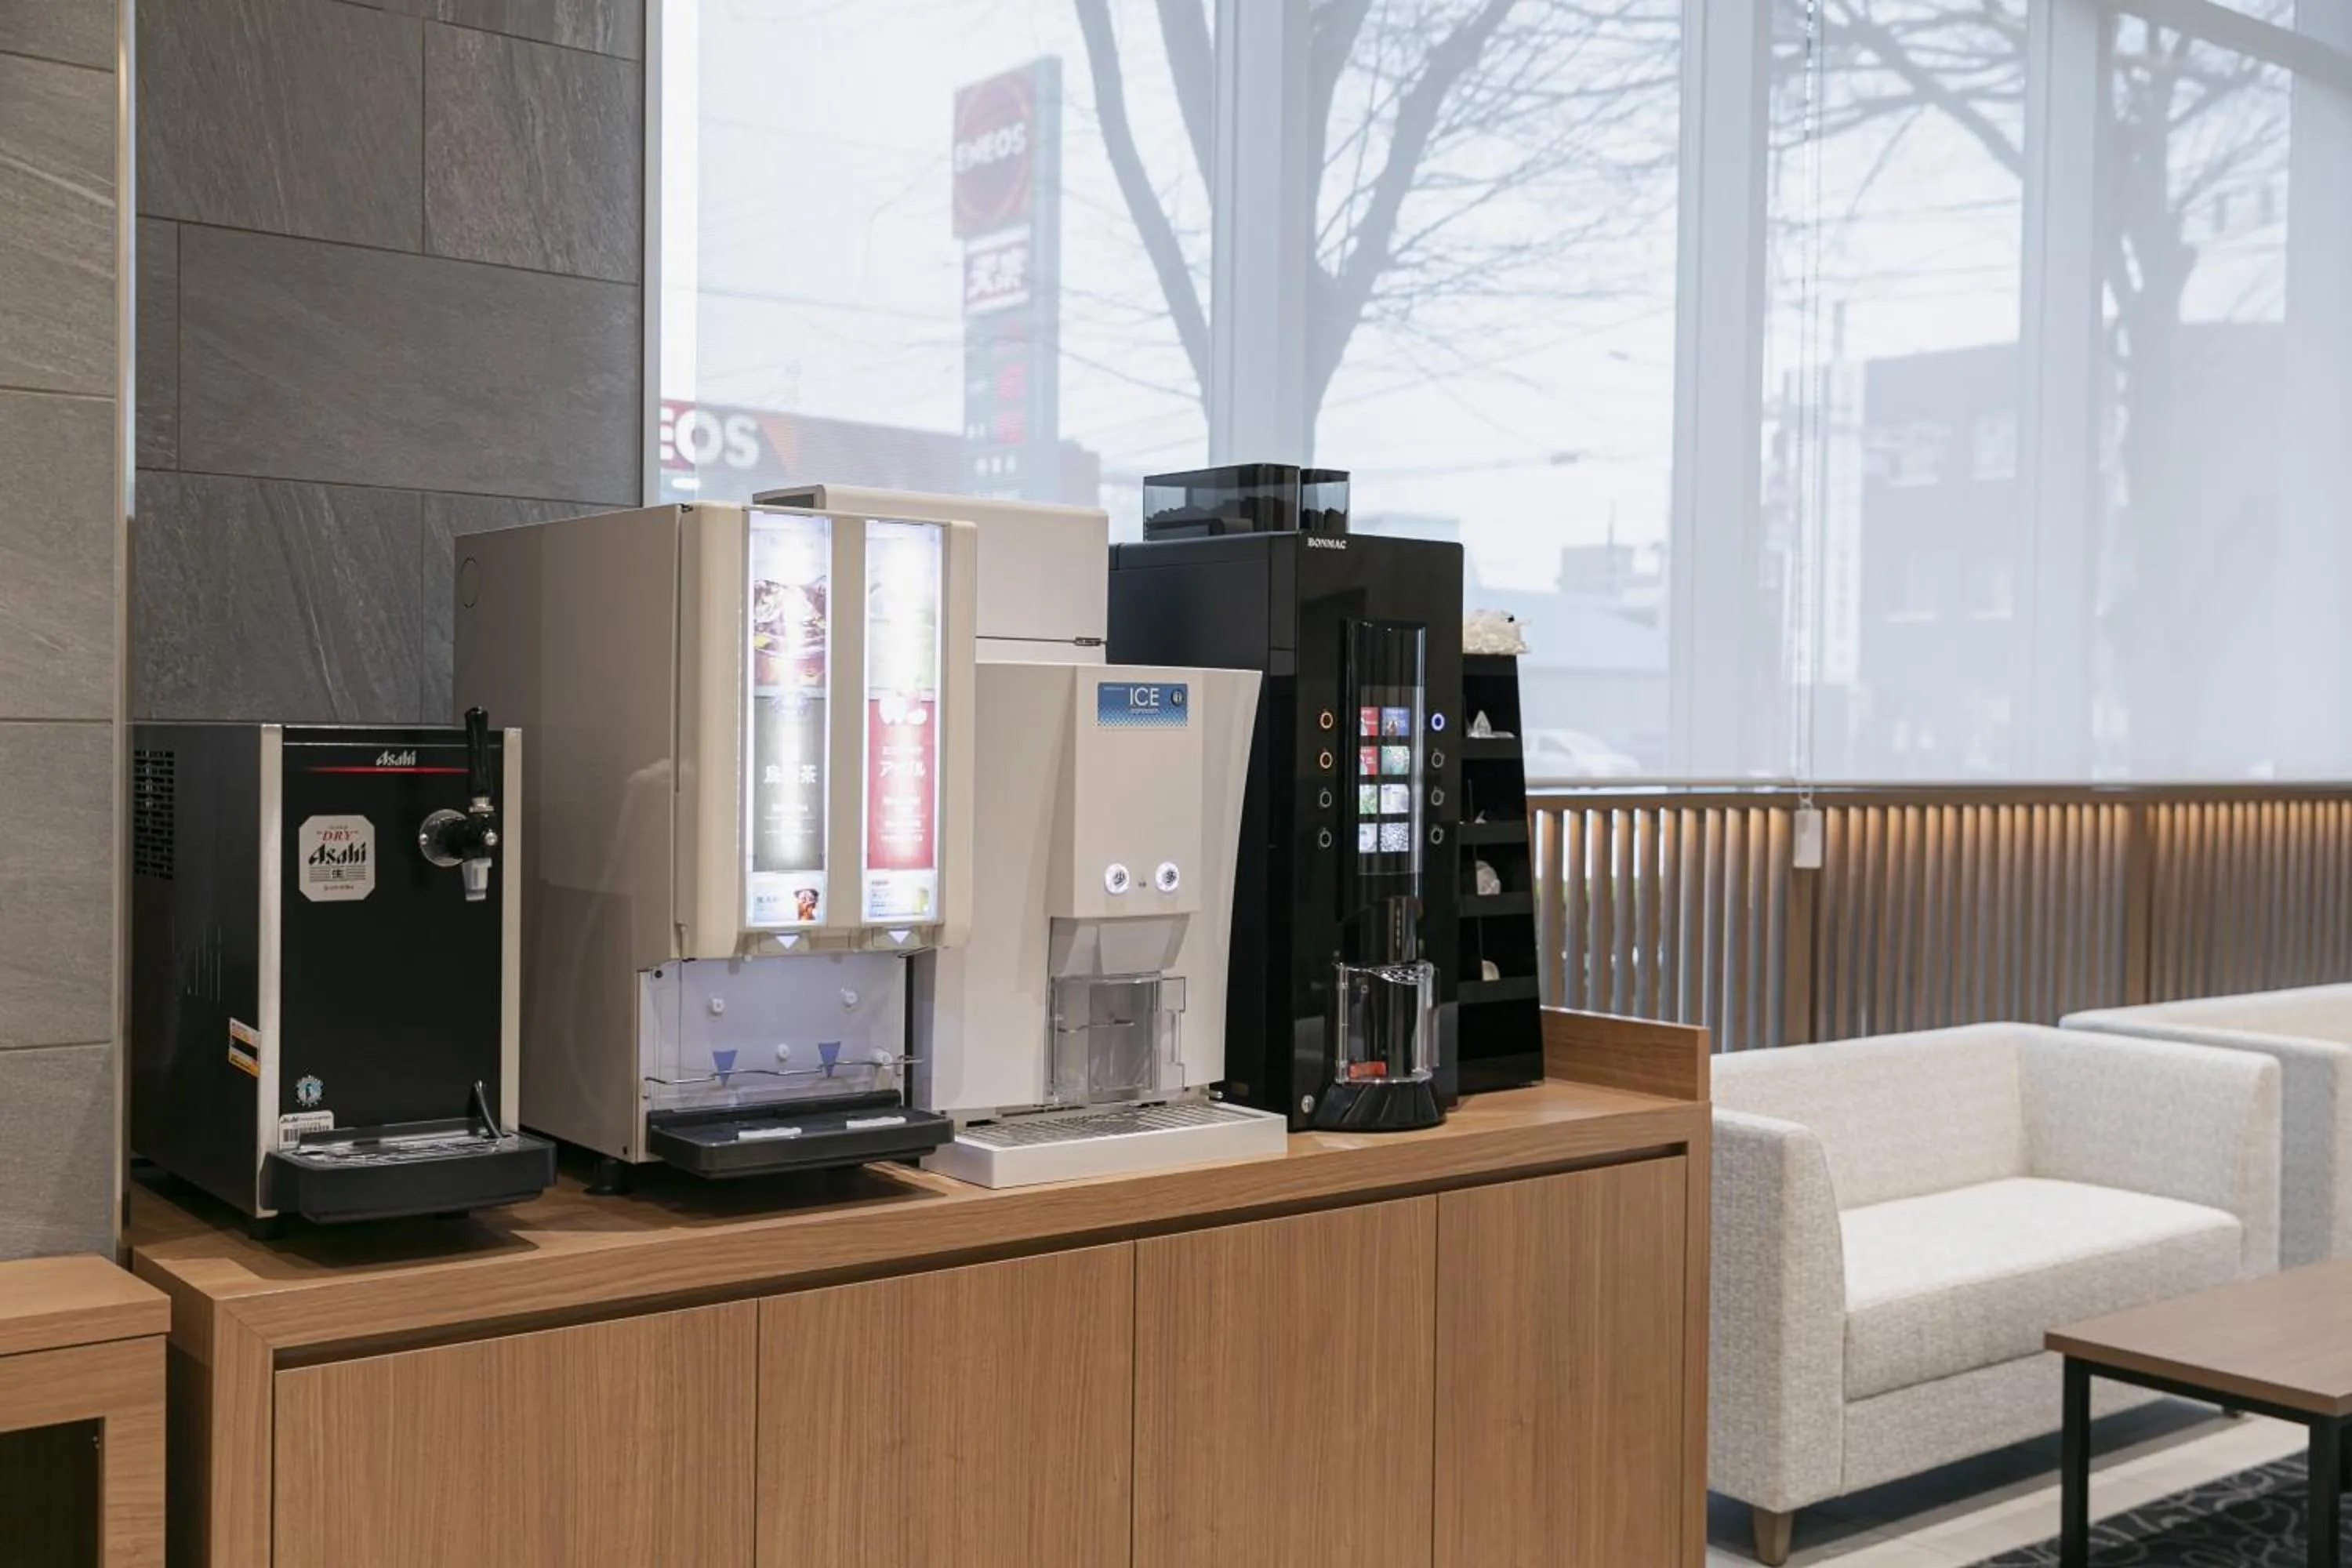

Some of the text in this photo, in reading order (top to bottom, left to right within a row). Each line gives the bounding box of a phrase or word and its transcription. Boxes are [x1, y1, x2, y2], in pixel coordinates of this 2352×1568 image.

[954, 122, 1027, 174] ENEOS
[1307, 536, 1347, 550] BONMAC
[1129, 687, 1160, 706] ICE
[376, 750, 416, 766] Asahi
[764, 764, 817, 784] 烏茶
[308, 841, 367, 865] Asahi
